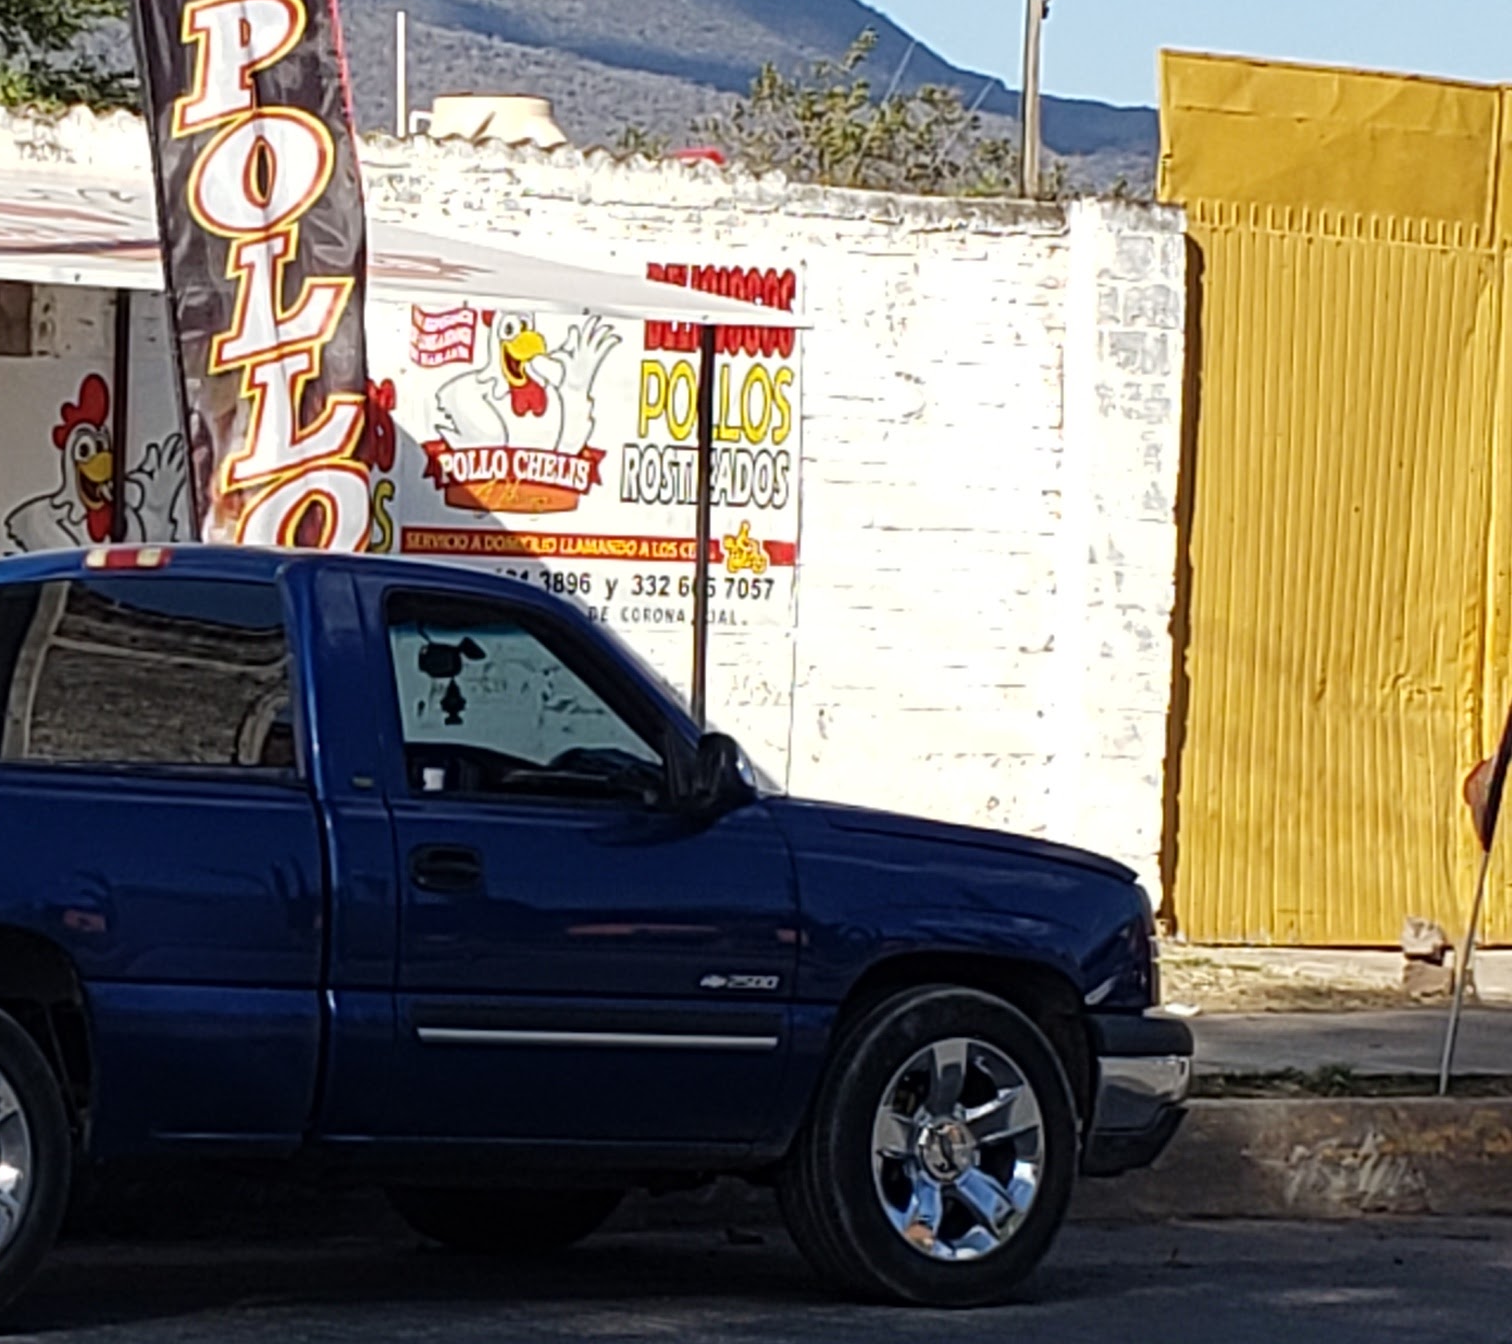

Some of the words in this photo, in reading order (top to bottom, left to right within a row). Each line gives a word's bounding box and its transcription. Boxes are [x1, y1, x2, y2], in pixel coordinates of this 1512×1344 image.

[438, 449, 508, 483] POLLO
[513, 449, 590, 491] CHELIS
[405, 531, 469, 551] SERVICIO
[471, 534, 483, 551] A
[485, 534, 557, 554] DOMICILIO
[559, 537, 637, 557] LLAMANDO
[639, 542, 649, 557] A
[652, 541, 677, 558] LOS
[605, 577, 618, 600] y
[631, 574, 670, 597] 332
[724, 577, 775, 601] 7057
